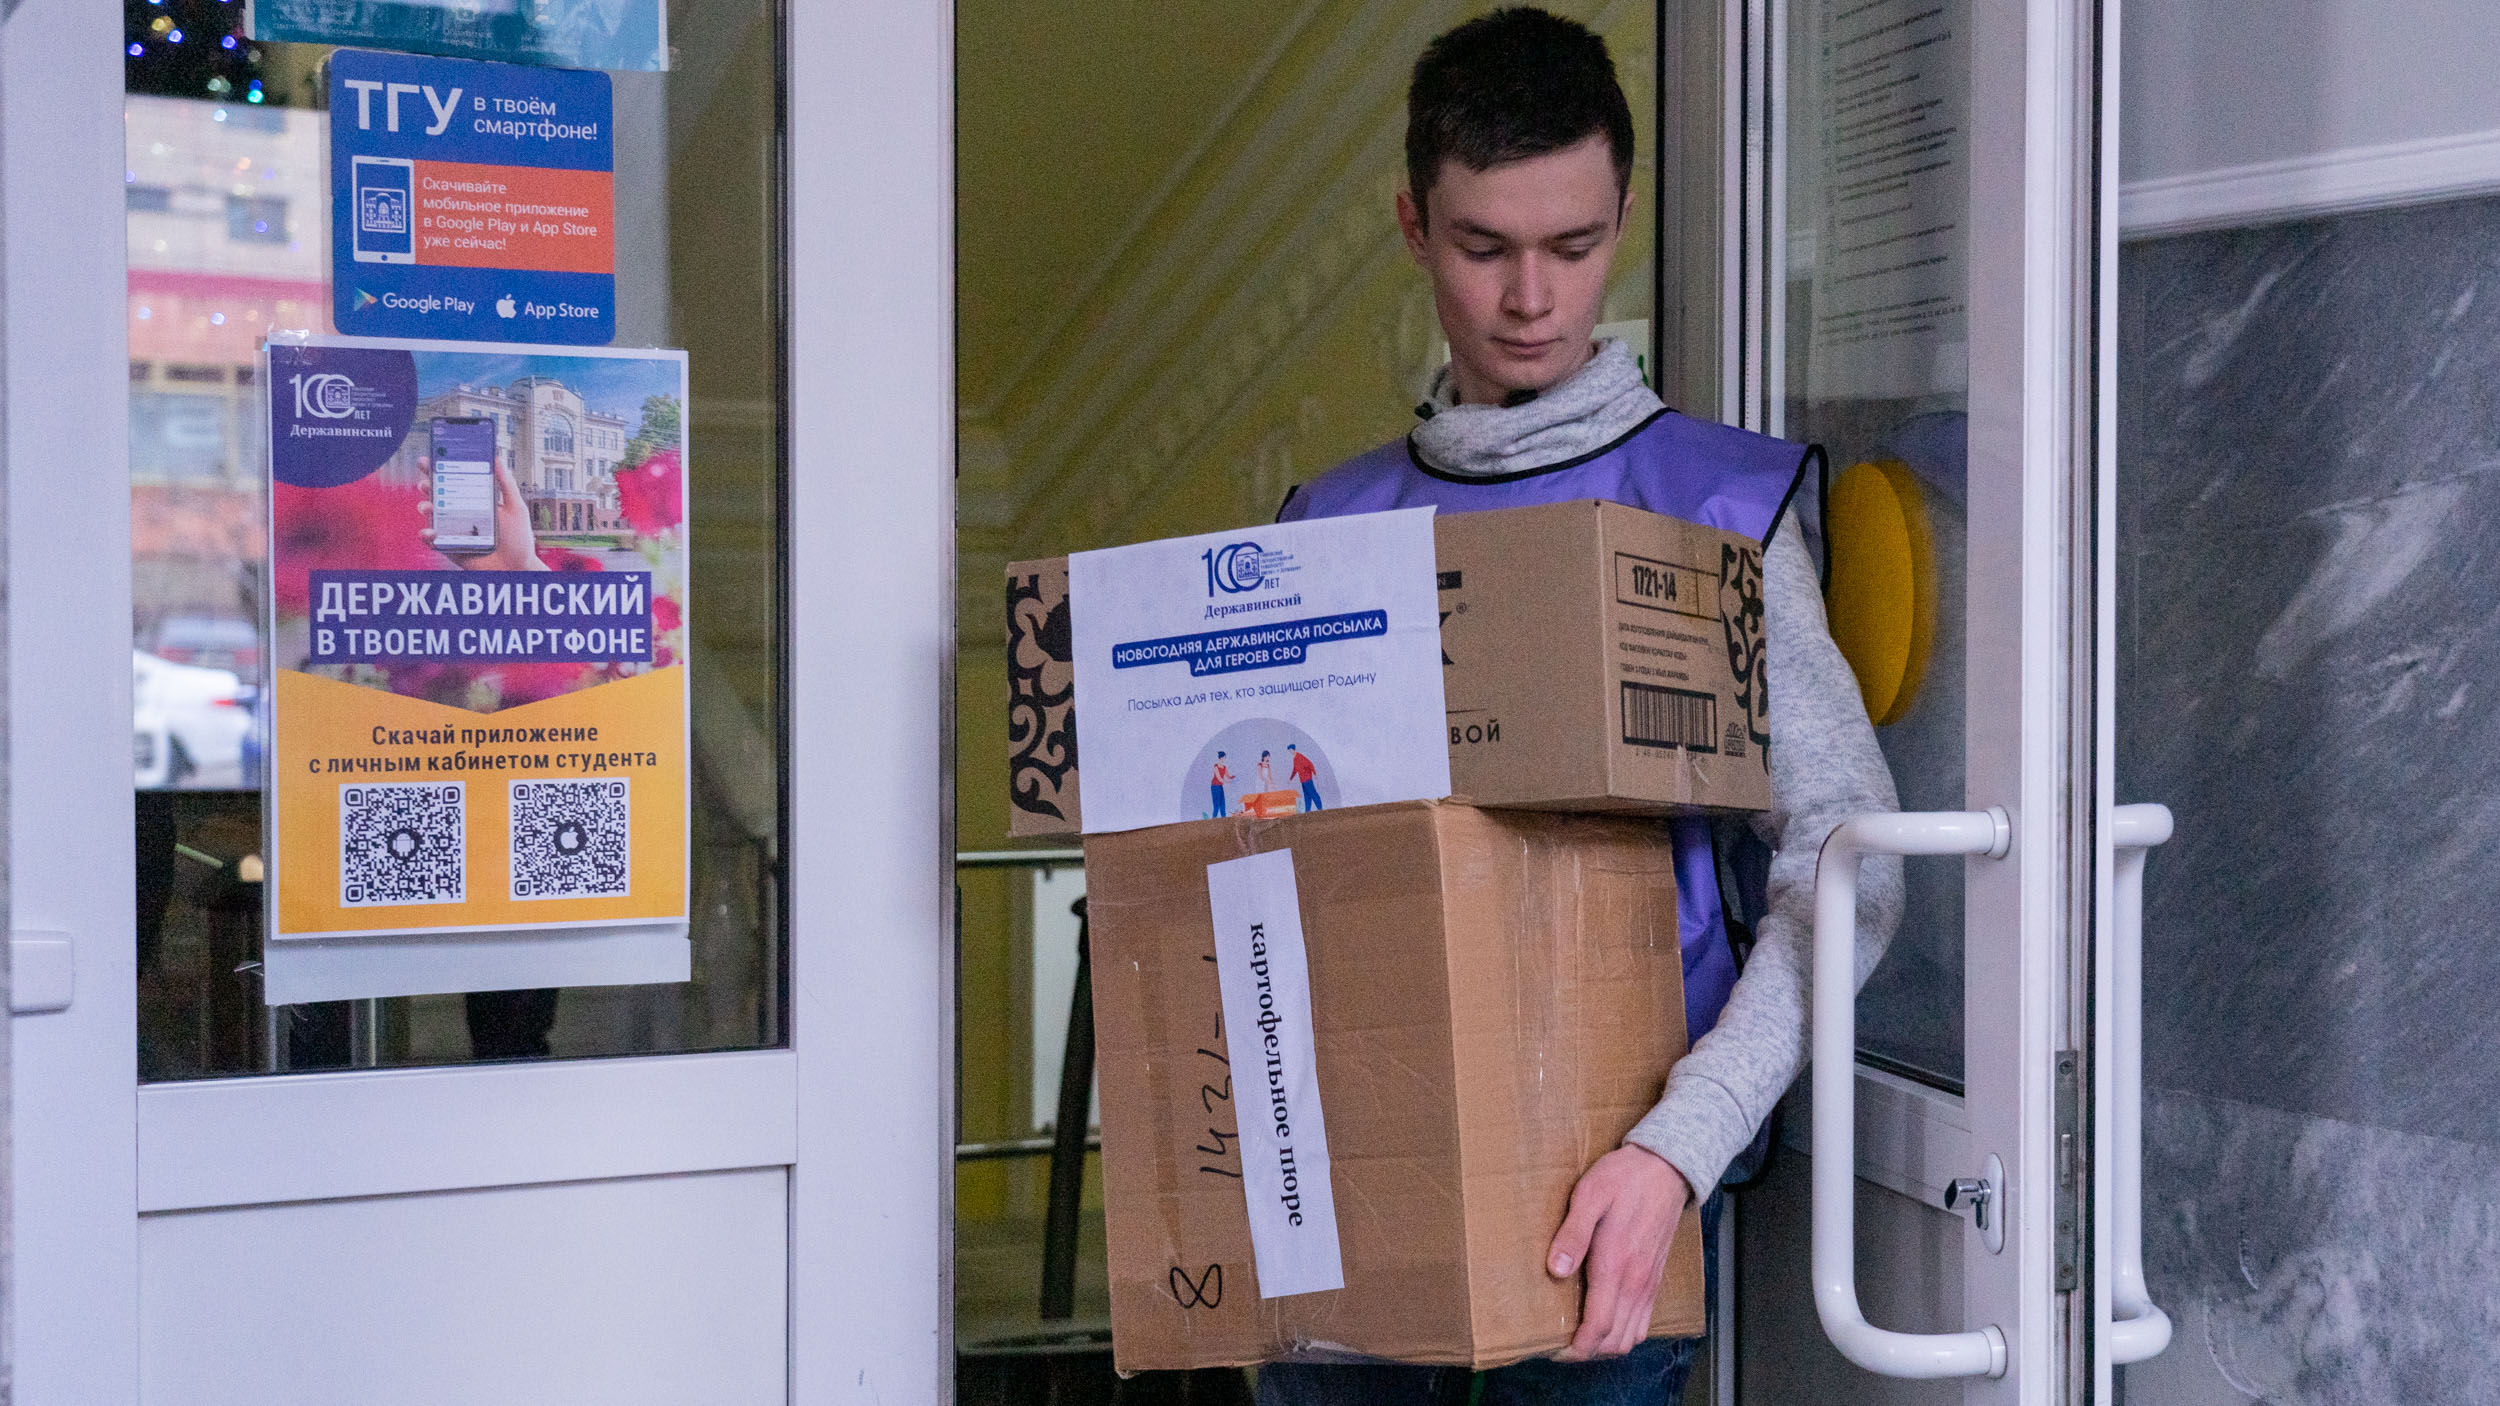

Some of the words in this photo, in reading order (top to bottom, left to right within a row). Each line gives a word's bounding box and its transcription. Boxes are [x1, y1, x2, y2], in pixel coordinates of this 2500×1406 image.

[344, 79, 463, 136] ТГУ
[474, 97, 486, 111] в
[493, 96, 556, 116] твоём
[474, 118, 598, 142] смартфоне!
[423, 177, 507, 194] Скачивайте
[423, 197, 502, 213] мобильное
[505, 203, 589, 217] приложение
[423, 217, 432, 228] в
[436, 216, 484, 233] Google
[488, 218, 517, 235] Play
[520, 223, 529, 233] и
[533, 221, 559, 237] App
[562, 222, 598, 237] Store
[424, 236, 450, 249] уже
[454, 236, 507, 250] сейчас!
[383, 292, 442, 314] Google
[444, 296, 475, 316] Play
[524, 301, 557, 320] App
[559, 303, 600, 318] Store
[290, 424, 393, 438] Державинский
[1632, 565, 1677, 602] 1721-14
[317, 576, 645, 621] ДЕРЖАВИНСКИЙ
[1204, 592, 1302, 620] Державинский
[317, 630, 336, 656] В
[344, 629, 451, 656] ТВОЕМ
[458, 627, 646, 656] СМАРТФОНЕ
[1116, 640, 1203, 664] НОВОГОДНЯЯ
[1205, 623, 1310, 653] ДЕРЖАВИНСКАЯ
[1313, 617, 1383, 638] ПОСЫЛКА
[1194, 656, 1223, 673] ДЛЯ
[1225, 650, 1270, 669] ГЕРОЕВ
[1273, 645, 1302, 661] СВО
[1127, 697, 1182, 712] Посылка
[1184, 693, 1207, 706] для
[1210, 688, 1233, 702] тех,
[1236, 685, 1256, 699] кто
[1259, 677, 1325, 697] защищает
[1328, 671, 1377, 688] Родину
[372, 724, 455, 746] Скачай
[461, 726, 599, 748] приложение
[309, 759, 321, 774] с
[327, 756, 421, 774] личным
[427, 751, 550, 771] кабинетом
[556, 750, 657, 773] студента
[1250, 921, 1291, 1139] картофельное
[1279, 1146, 1304, 1228] пюре
[1169, 1263, 1223, 1309] 8
